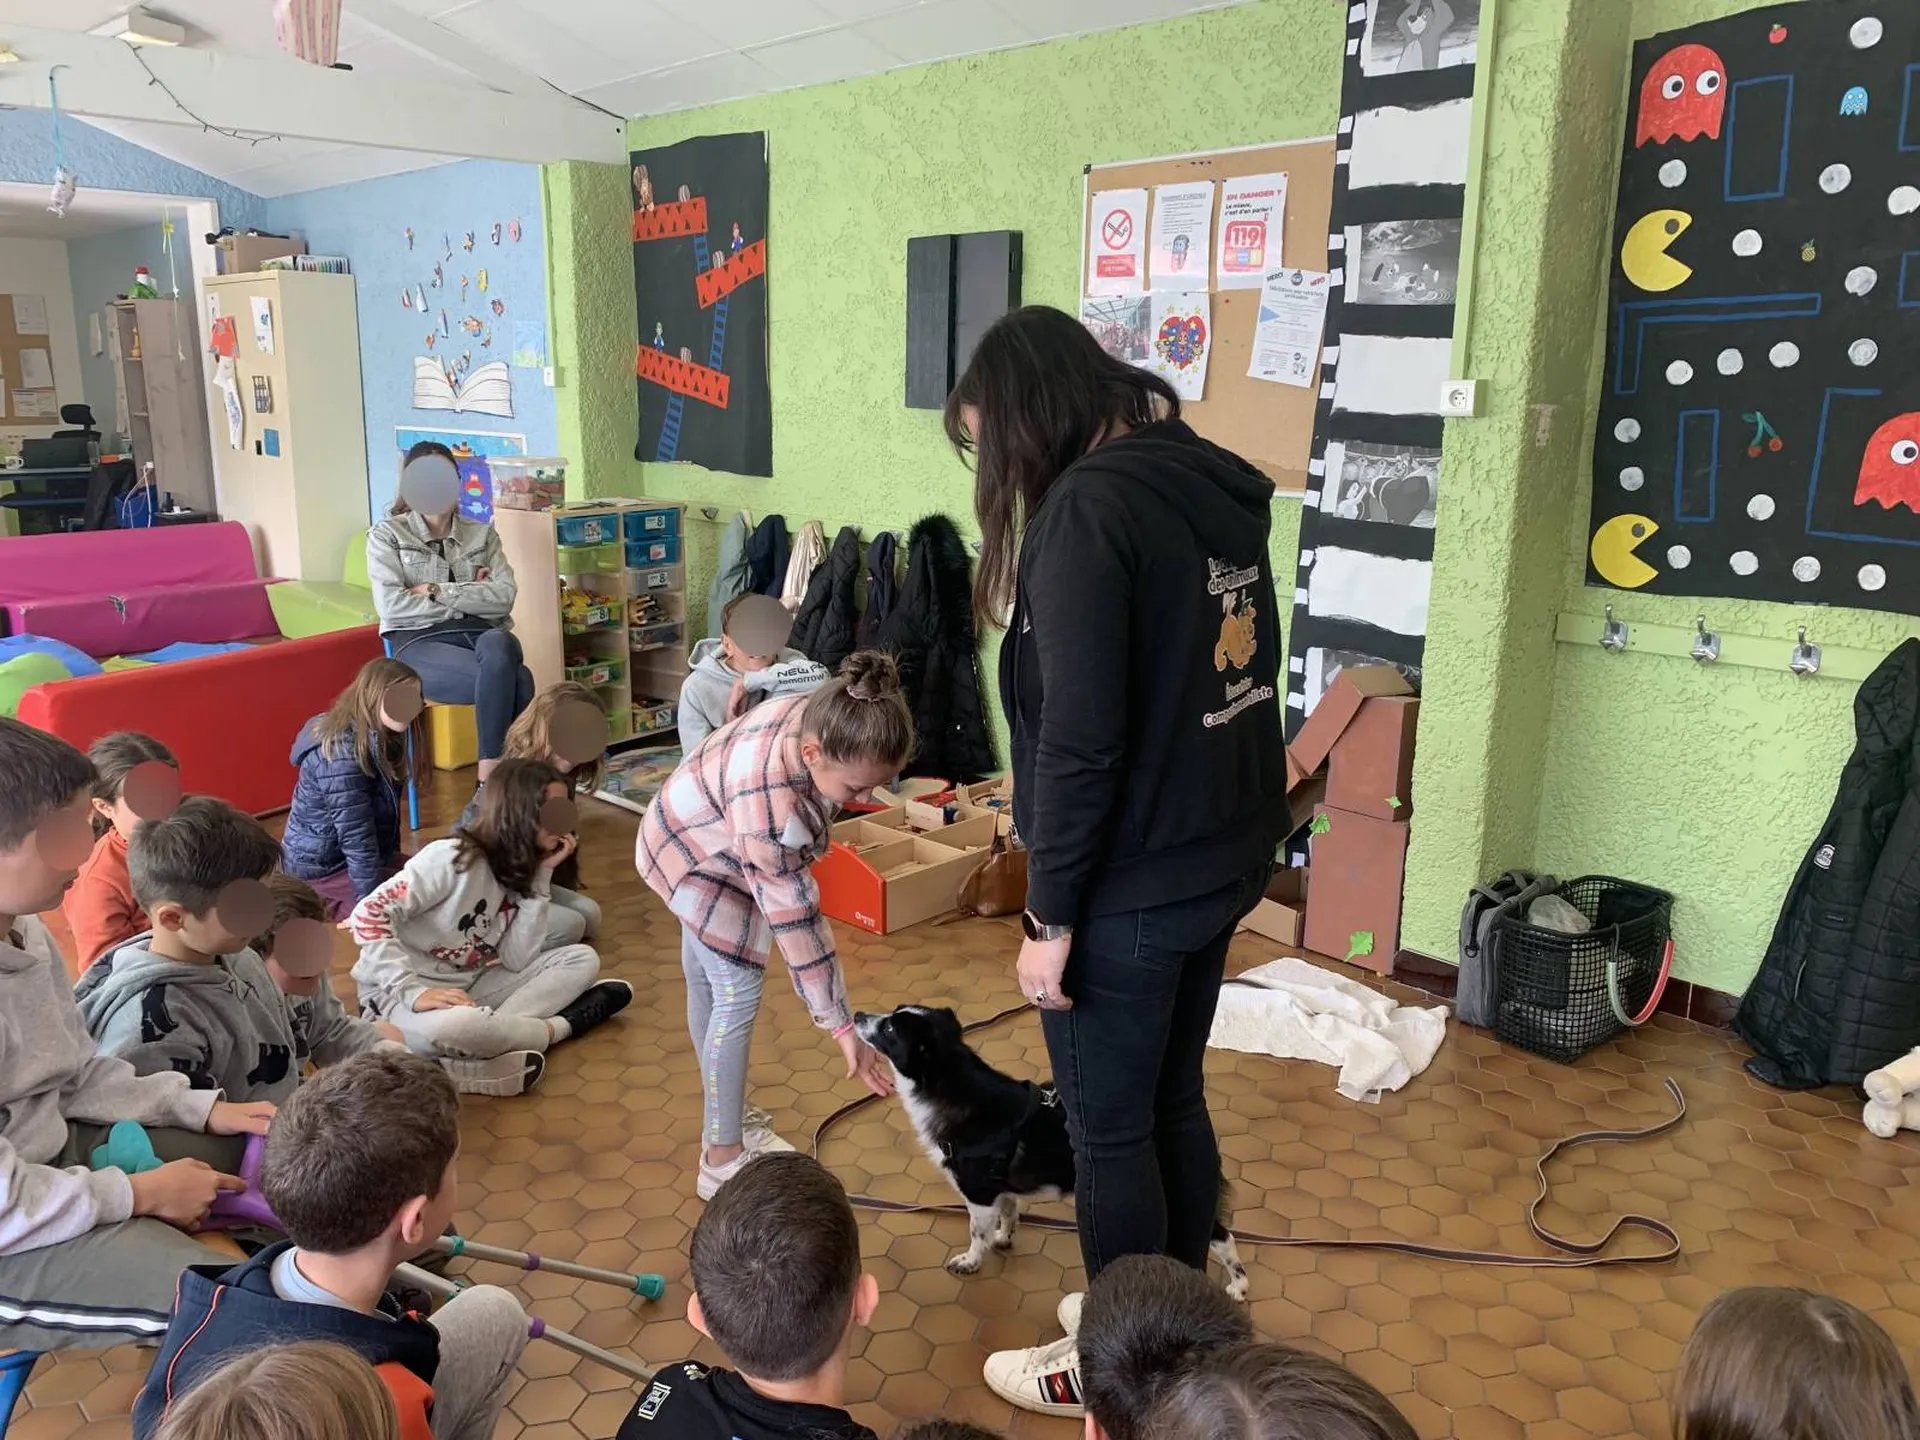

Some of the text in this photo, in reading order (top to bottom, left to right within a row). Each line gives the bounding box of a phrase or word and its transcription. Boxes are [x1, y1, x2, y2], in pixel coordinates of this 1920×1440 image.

[1239, 190, 1274, 200] DANGER
[1232, 227, 1260, 247] 119
[777, 667, 809, 678] NEW
